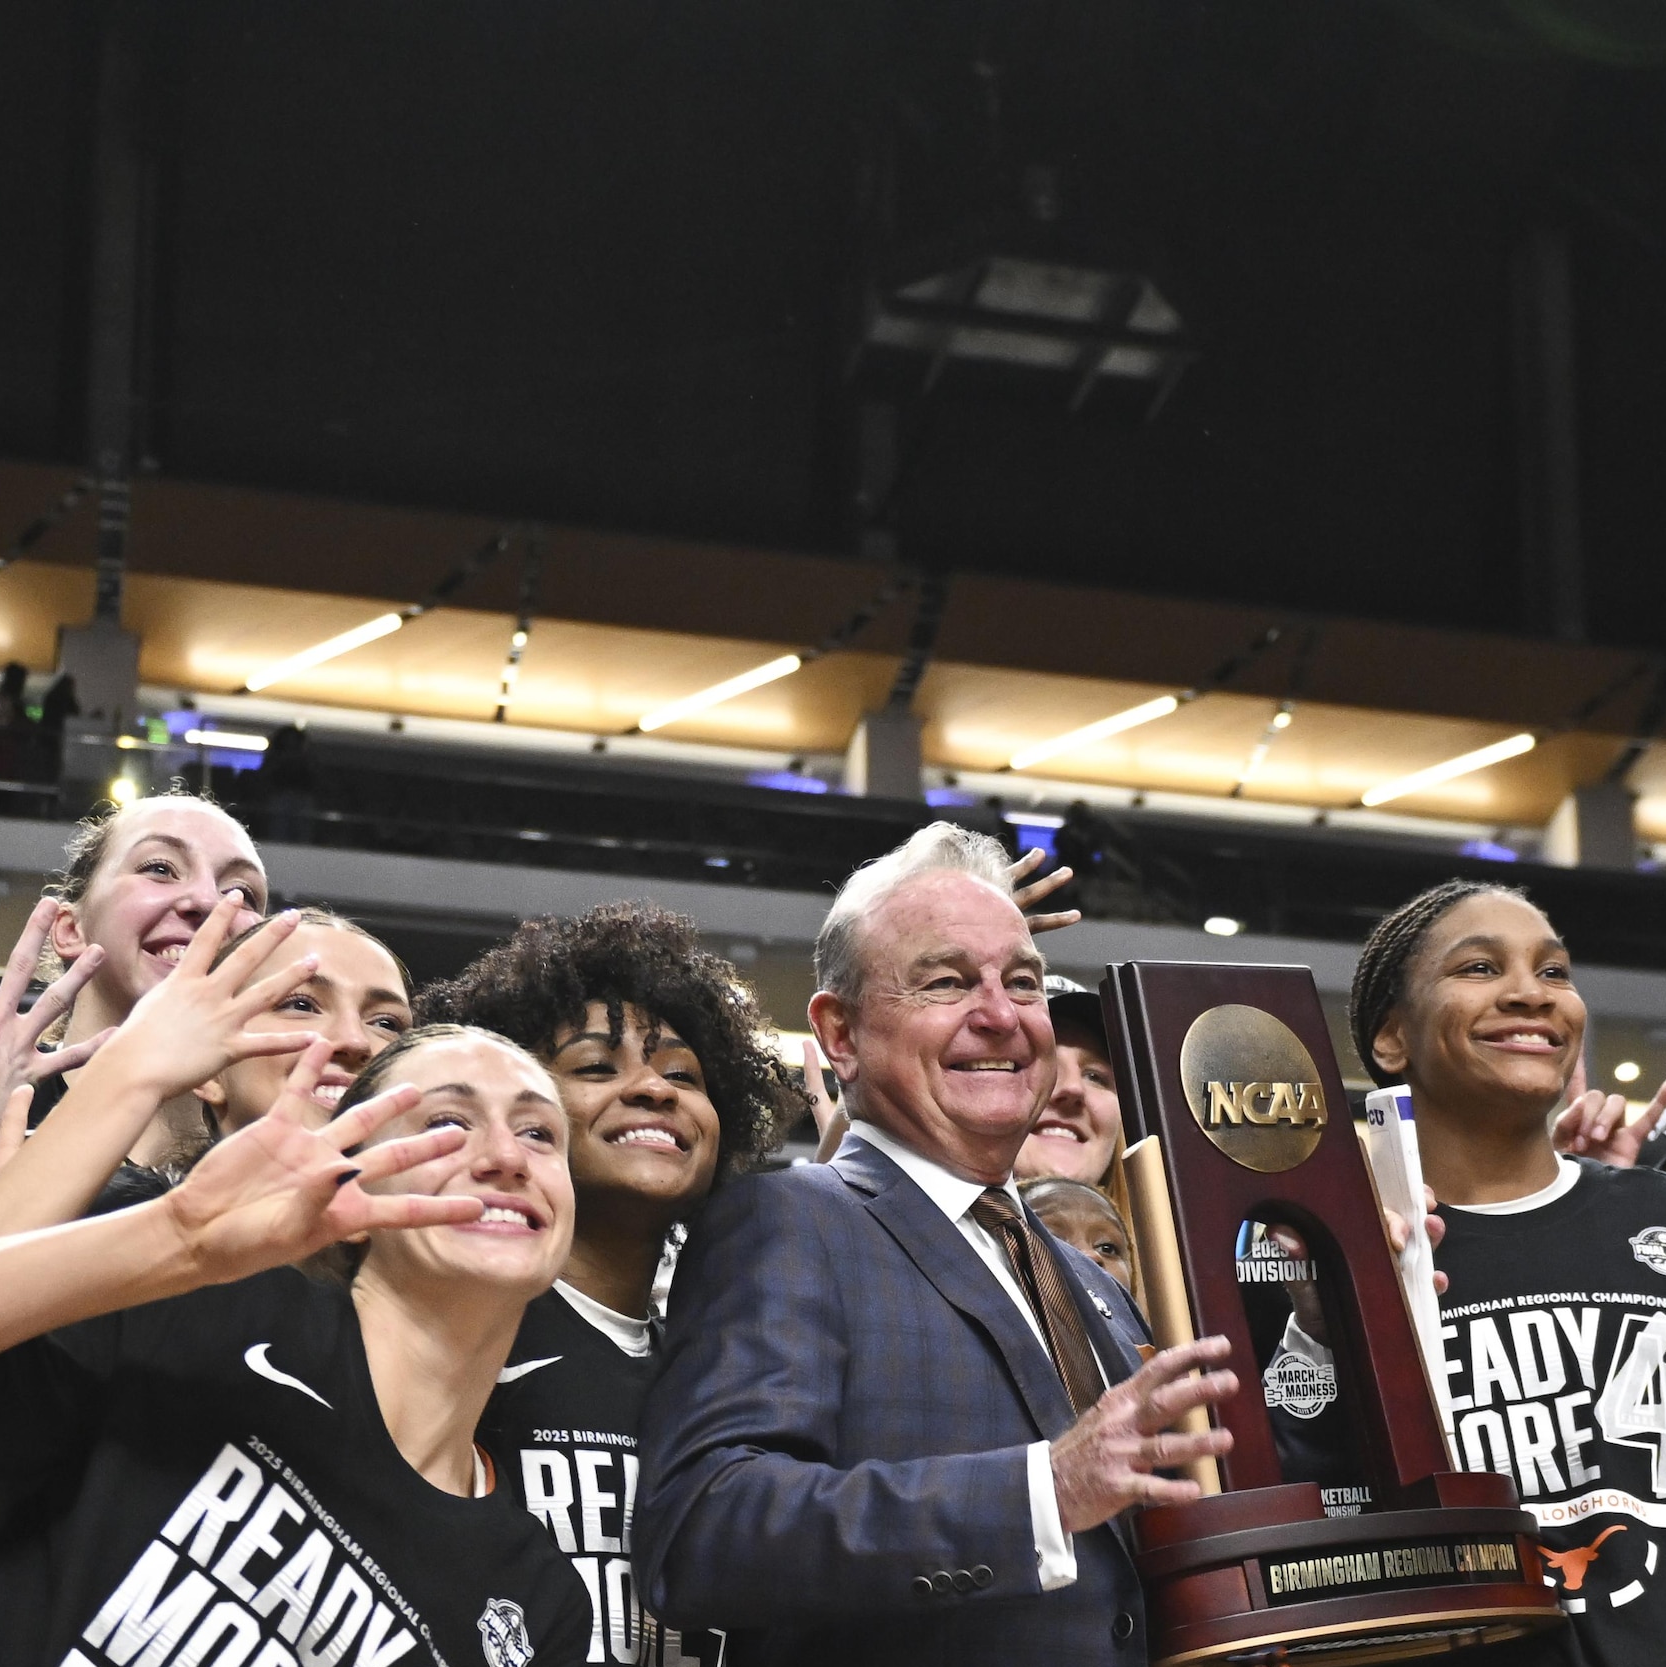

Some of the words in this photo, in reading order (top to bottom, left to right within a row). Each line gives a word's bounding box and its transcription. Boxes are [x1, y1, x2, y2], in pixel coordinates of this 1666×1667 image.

[1205, 1081, 1328, 1130] NCAA
[1367, 1108, 1384, 1127] CU
[1236, 1260, 1308, 1283] DIVISION
[1441, 1297, 1515, 1321] MINGHAM
[1517, 1292, 1589, 1306] REGIONAL
[1441, 1307, 1601, 1413] EADY
[1277, 1369, 1315, 1384] MARCH
[1285, 1382, 1336, 1398] MADNESS
[533, 1428, 570, 1443] 2025
[1448, 1390, 1601, 1497] ORE
[1320, 1486, 1372, 1505] KETBALL
[1541, 1494, 1647, 1521] LONGHORNS
[246, 1434, 283, 1471] 2025
[282, 1466, 364, 1560] BIRMINGHAM
[361, 1555, 421, 1627] REGIONAL
[1270, 1551, 1381, 1594] BIRMINGHAM
[1384, 1545, 1454, 1579] REGIONAL
[1455, 1543, 1517, 1573] CHAMPION
